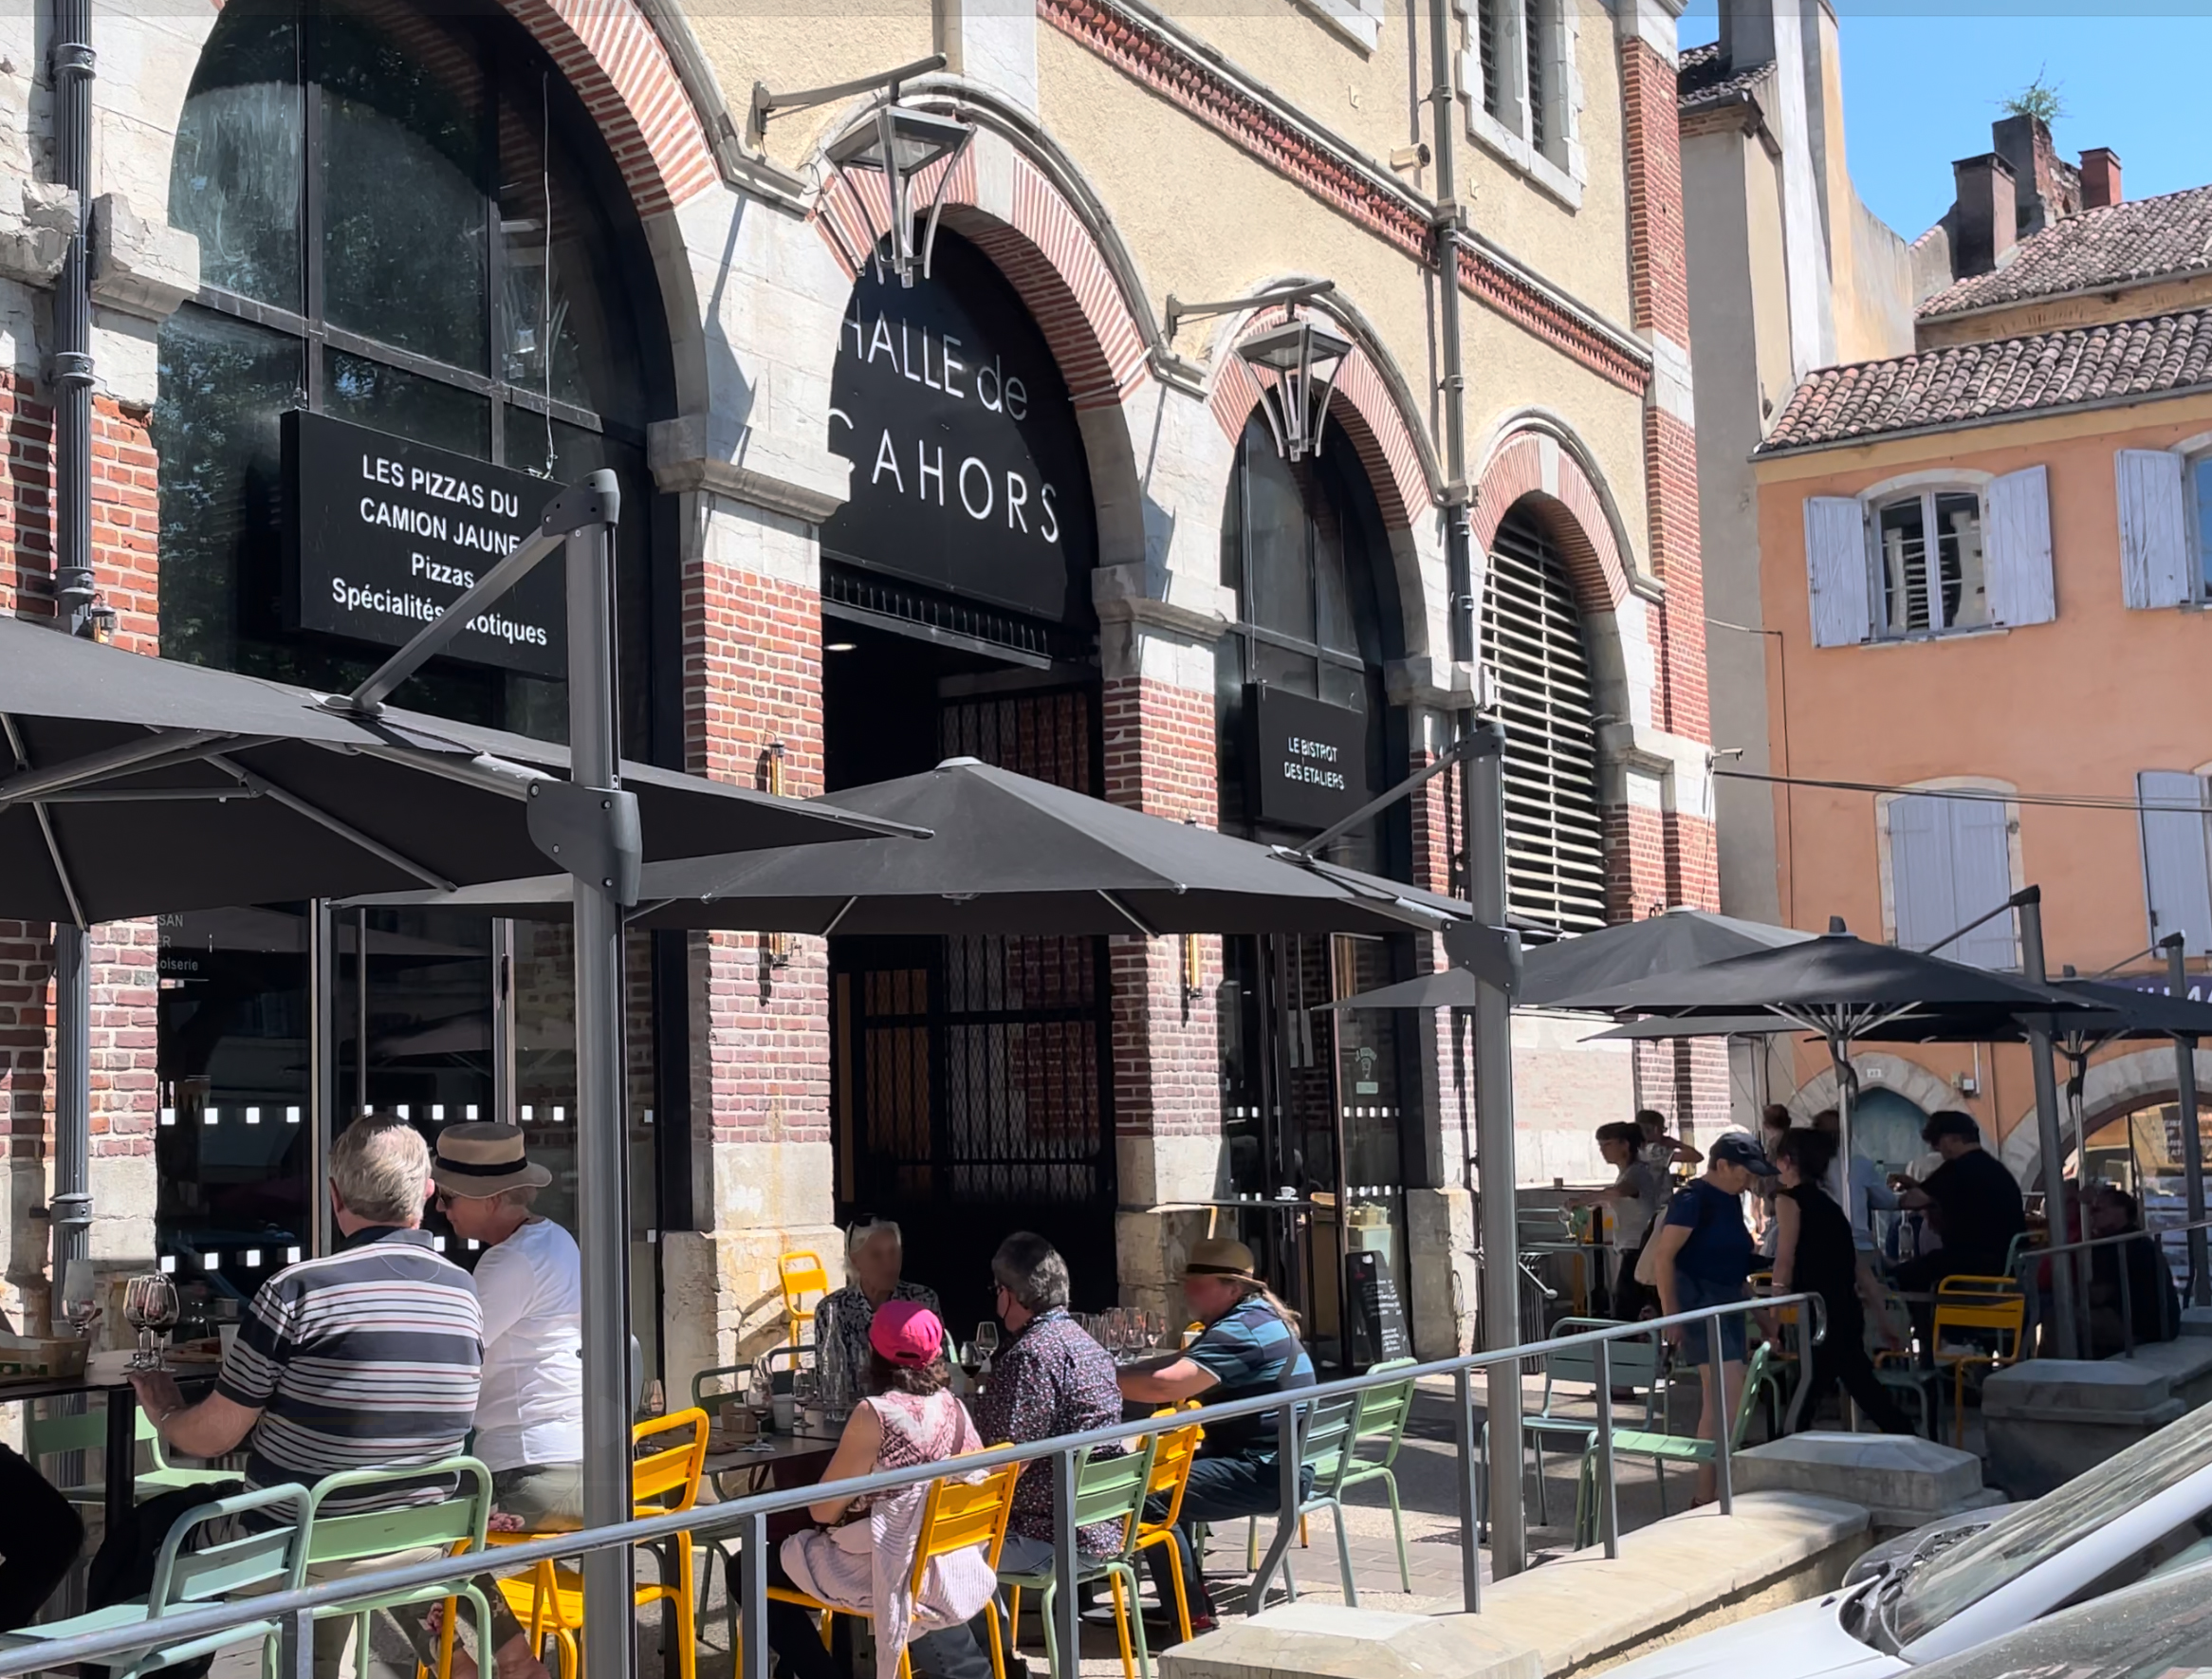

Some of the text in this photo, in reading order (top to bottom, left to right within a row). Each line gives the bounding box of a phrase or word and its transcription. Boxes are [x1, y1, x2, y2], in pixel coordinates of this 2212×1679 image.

[977, 354, 1028, 420] de
[362, 453, 519, 518] LES PIZZAS DU
[359, 496, 522, 557] CAMION JAUNE
[411, 552, 475, 589] Pizzas
[332, 577, 446, 623] Spécialités
[1288, 736, 1338, 764] LE BISTROT
[1283, 761, 1345, 791] DES ETALIERS
